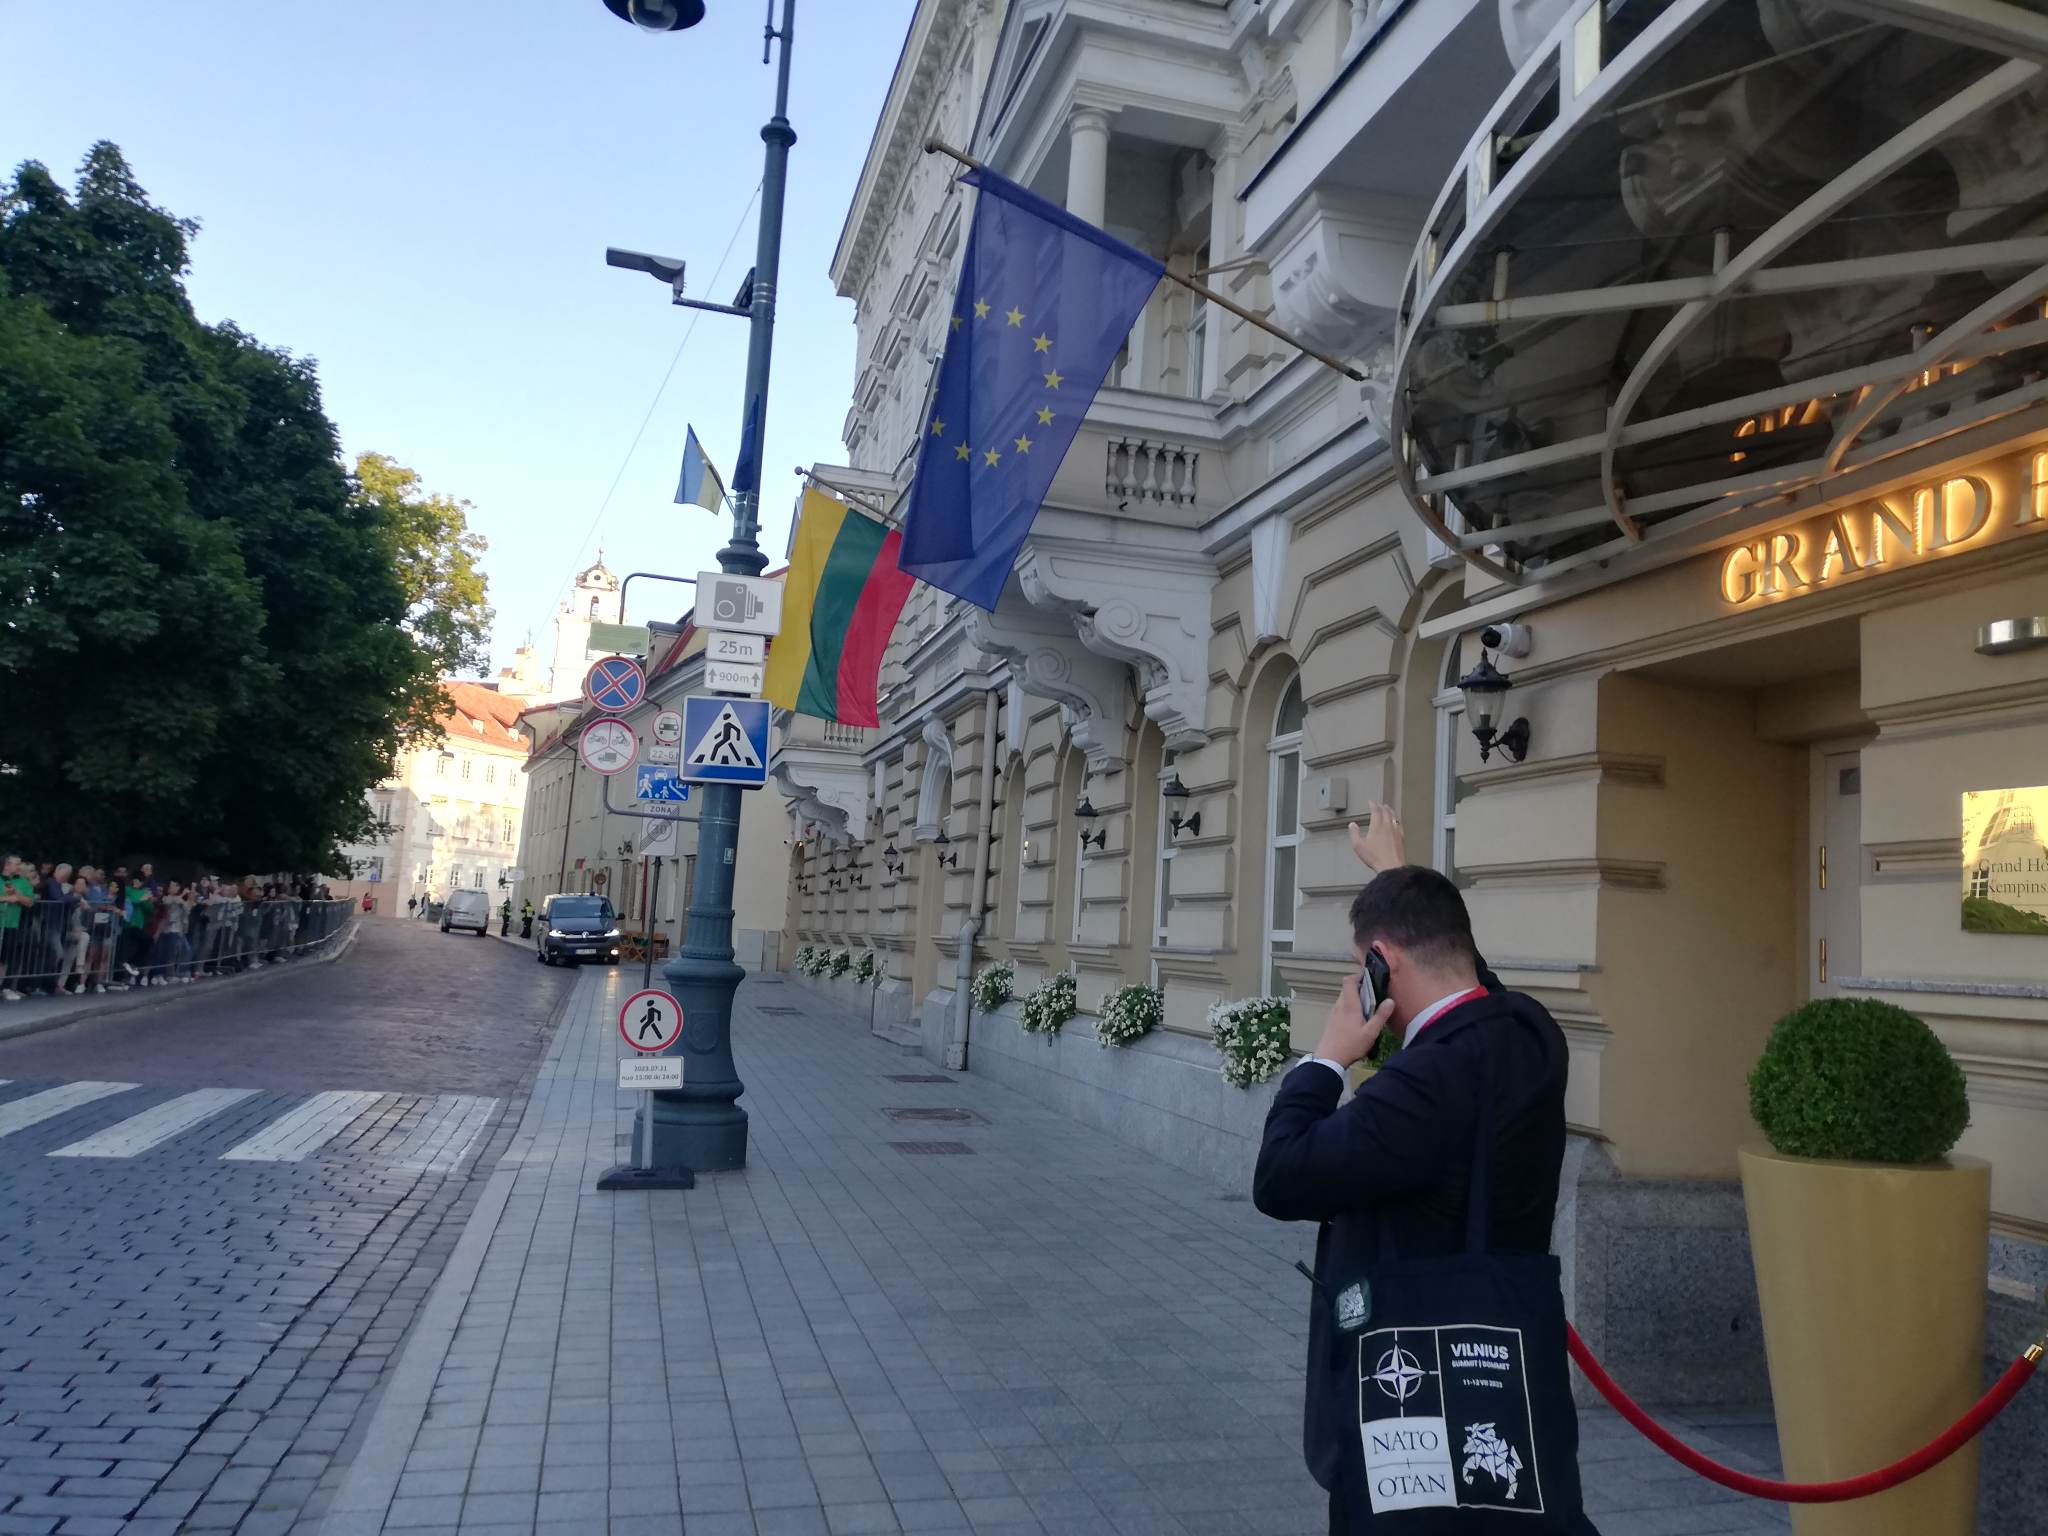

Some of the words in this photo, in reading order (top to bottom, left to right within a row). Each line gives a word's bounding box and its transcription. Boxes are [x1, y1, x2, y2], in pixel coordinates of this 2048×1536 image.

[1720, 474, 1993, 604] GRAND
[719, 671, 749, 683] 900m
[650, 806, 672, 814] ZONA
[1979, 857, 2022, 872] Grand
[1450, 1343, 1509, 1360] VILNIUS
[1372, 1430, 1438, 1454] NATO
[1377, 1474, 1448, 1498] OTAN
